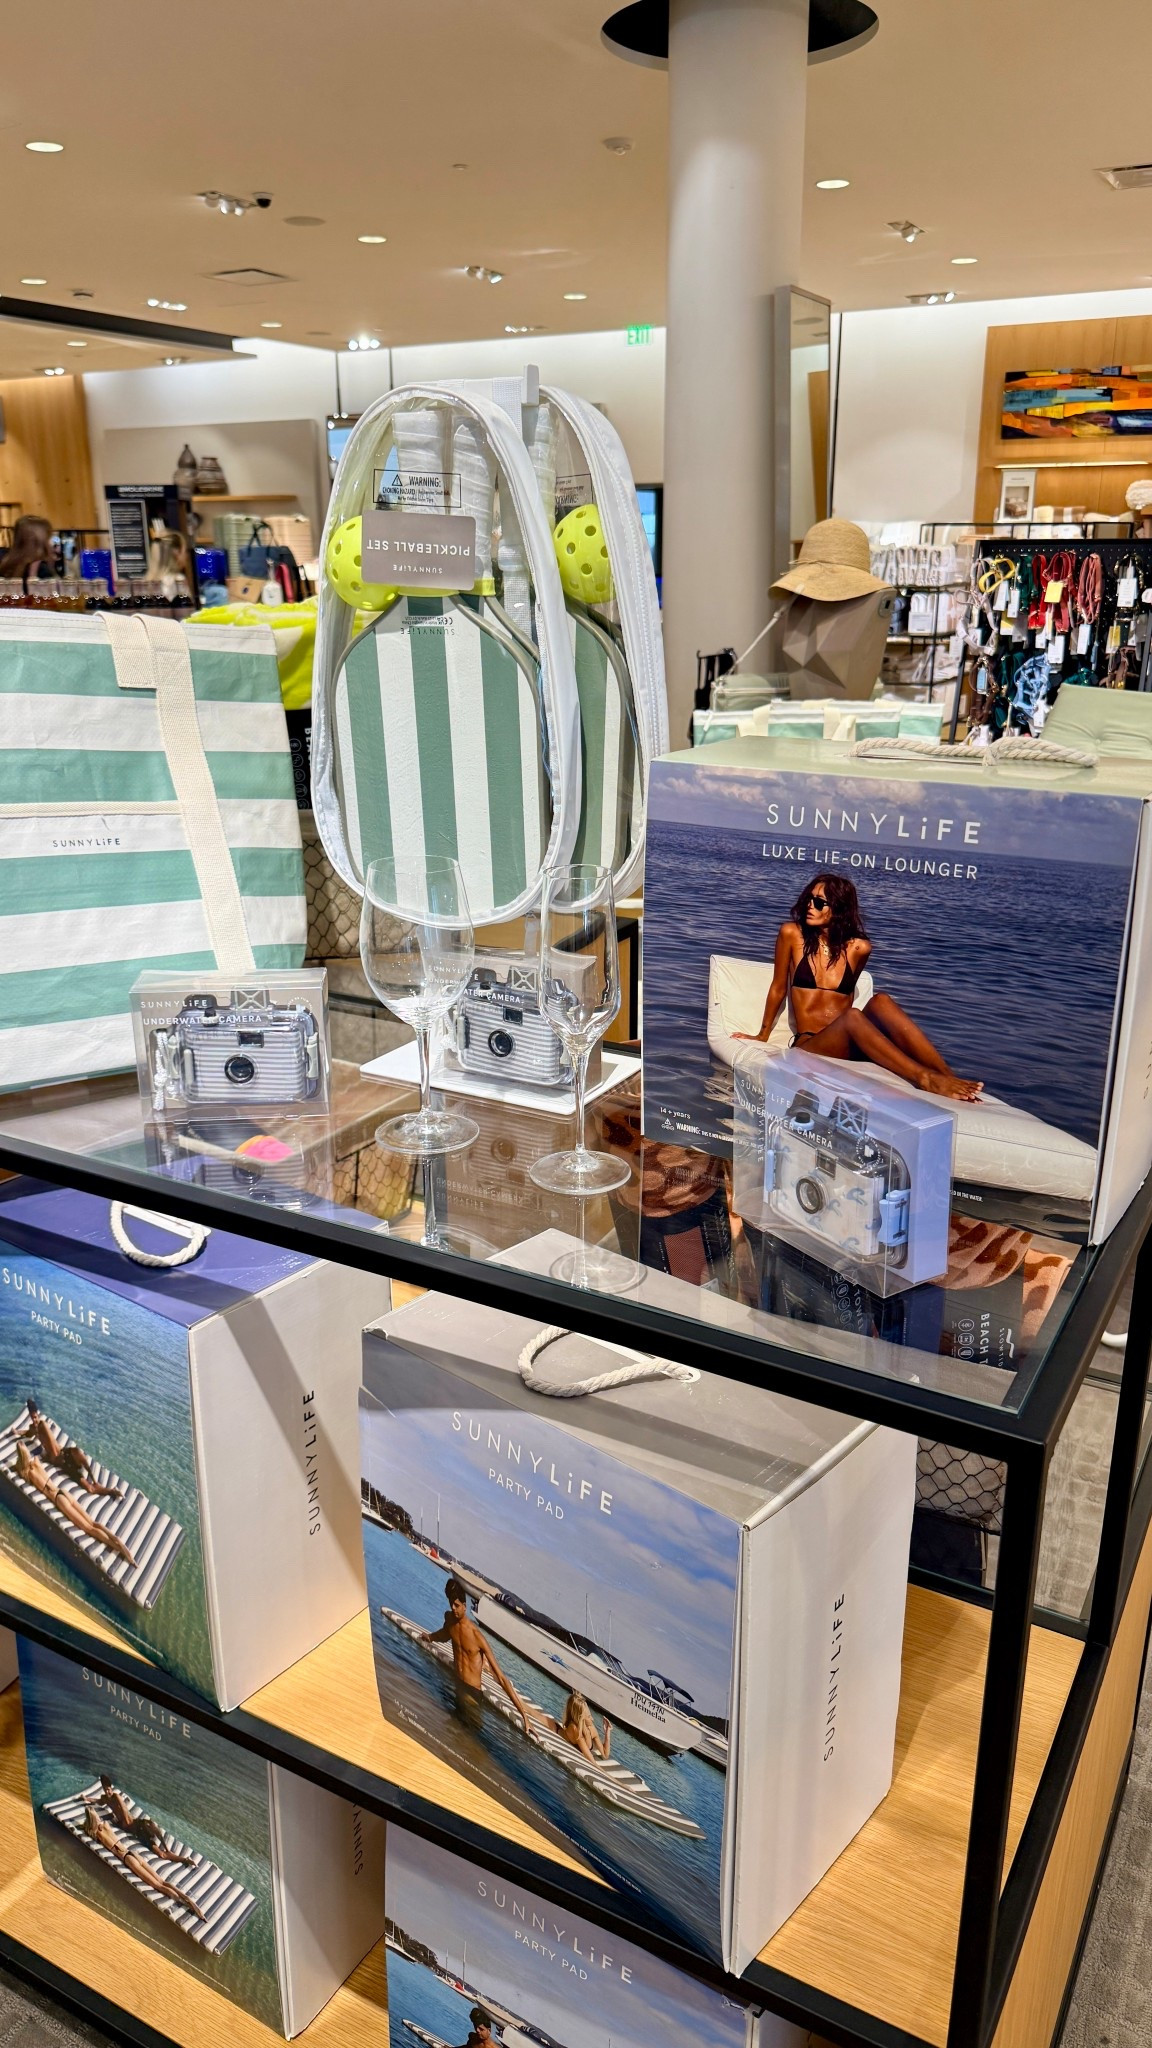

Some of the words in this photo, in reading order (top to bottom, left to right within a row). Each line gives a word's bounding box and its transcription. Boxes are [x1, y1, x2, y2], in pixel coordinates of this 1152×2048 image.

[628, 325, 651, 345] EXIT
[408, 476, 442, 488] WARNING:
[366, 540, 389, 551] SET
[394, 541, 470, 556] PICKLEBALL
[766, 803, 982, 844] SUNNYLiFE
[762, 843, 807, 861] LUXE
[814, 850, 876, 868] LIE-ON
[884, 856, 978, 880] LOUNGER
[486, 992, 520, 1003] CAMERA
[143, 1016, 215, 1026] UNDERWATER
[218, 1015, 262, 1024] CAMERA
[660, 1106, 667, 1114] 14
[673, 1110, 691, 1120] years
[676, 1122, 701, 1135] WARNING:
[740, 1099, 794, 1130] UNDERWATER
[797, 1126, 833, 1150] CAMERA
[2, 1268, 110, 1336] SUNNYLiFE
[31, 1310, 60, 1334] PARTY
[64, 1328, 82, 1345] PAD
[980, 1312, 990, 1354] BEACH
[452, 1411, 613, 1515] SUNNYLiFE
[488, 1468, 531, 1500] PARTY
[537, 1495, 564, 1520] PAD
[110, 1704, 140, 1728] PARTY
[143, 1724, 162, 1741] PAD
[477, 1880, 633, 1984] SUNNYLiFE
[514, 1930, 556, 1962] PARTY
[561, 1958, 588, 1980] PAD
